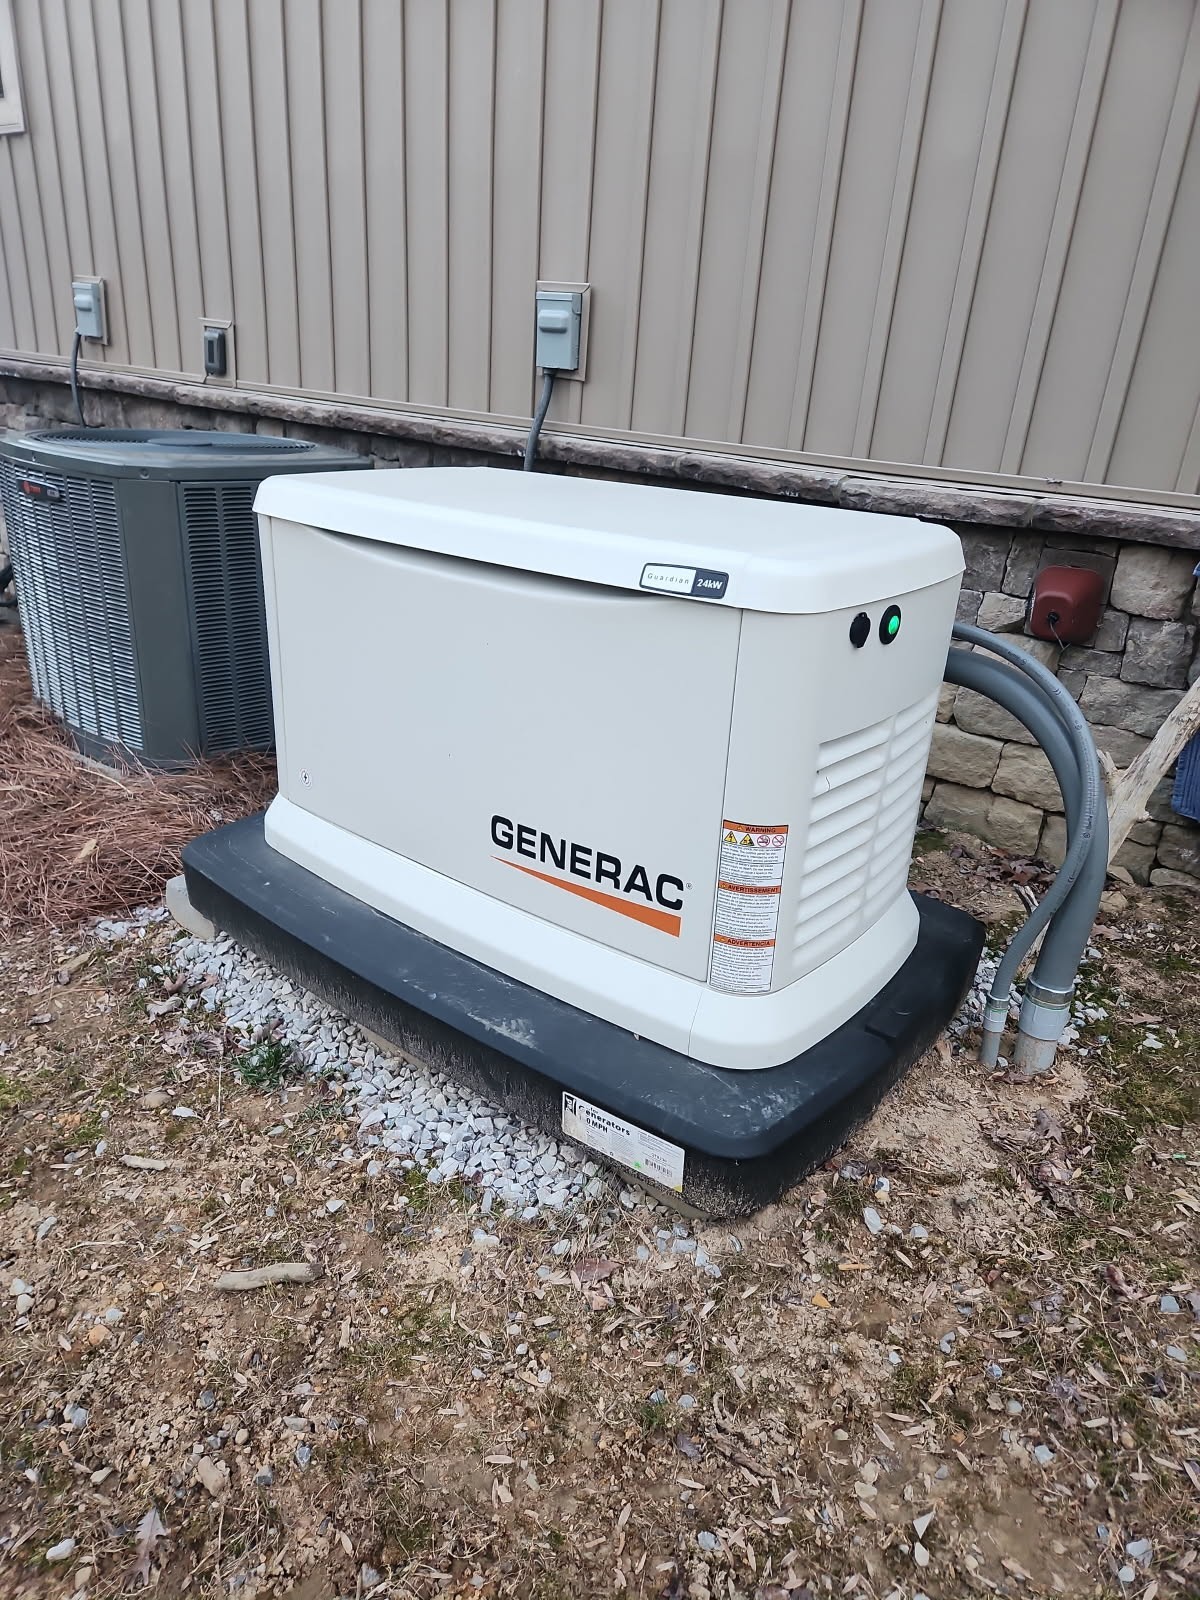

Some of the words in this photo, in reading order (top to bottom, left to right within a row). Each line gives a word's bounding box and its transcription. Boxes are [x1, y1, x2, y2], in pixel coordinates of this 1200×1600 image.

[647, 572, 689, 585] Guardian
[697, 578, 723, 590] 24kW
[491, 814, 684, 911] GENERAC
[728, 883, 779, 893] AVERTISSEMENT
[727, 938, 771, 947] ADVERTENCIA
